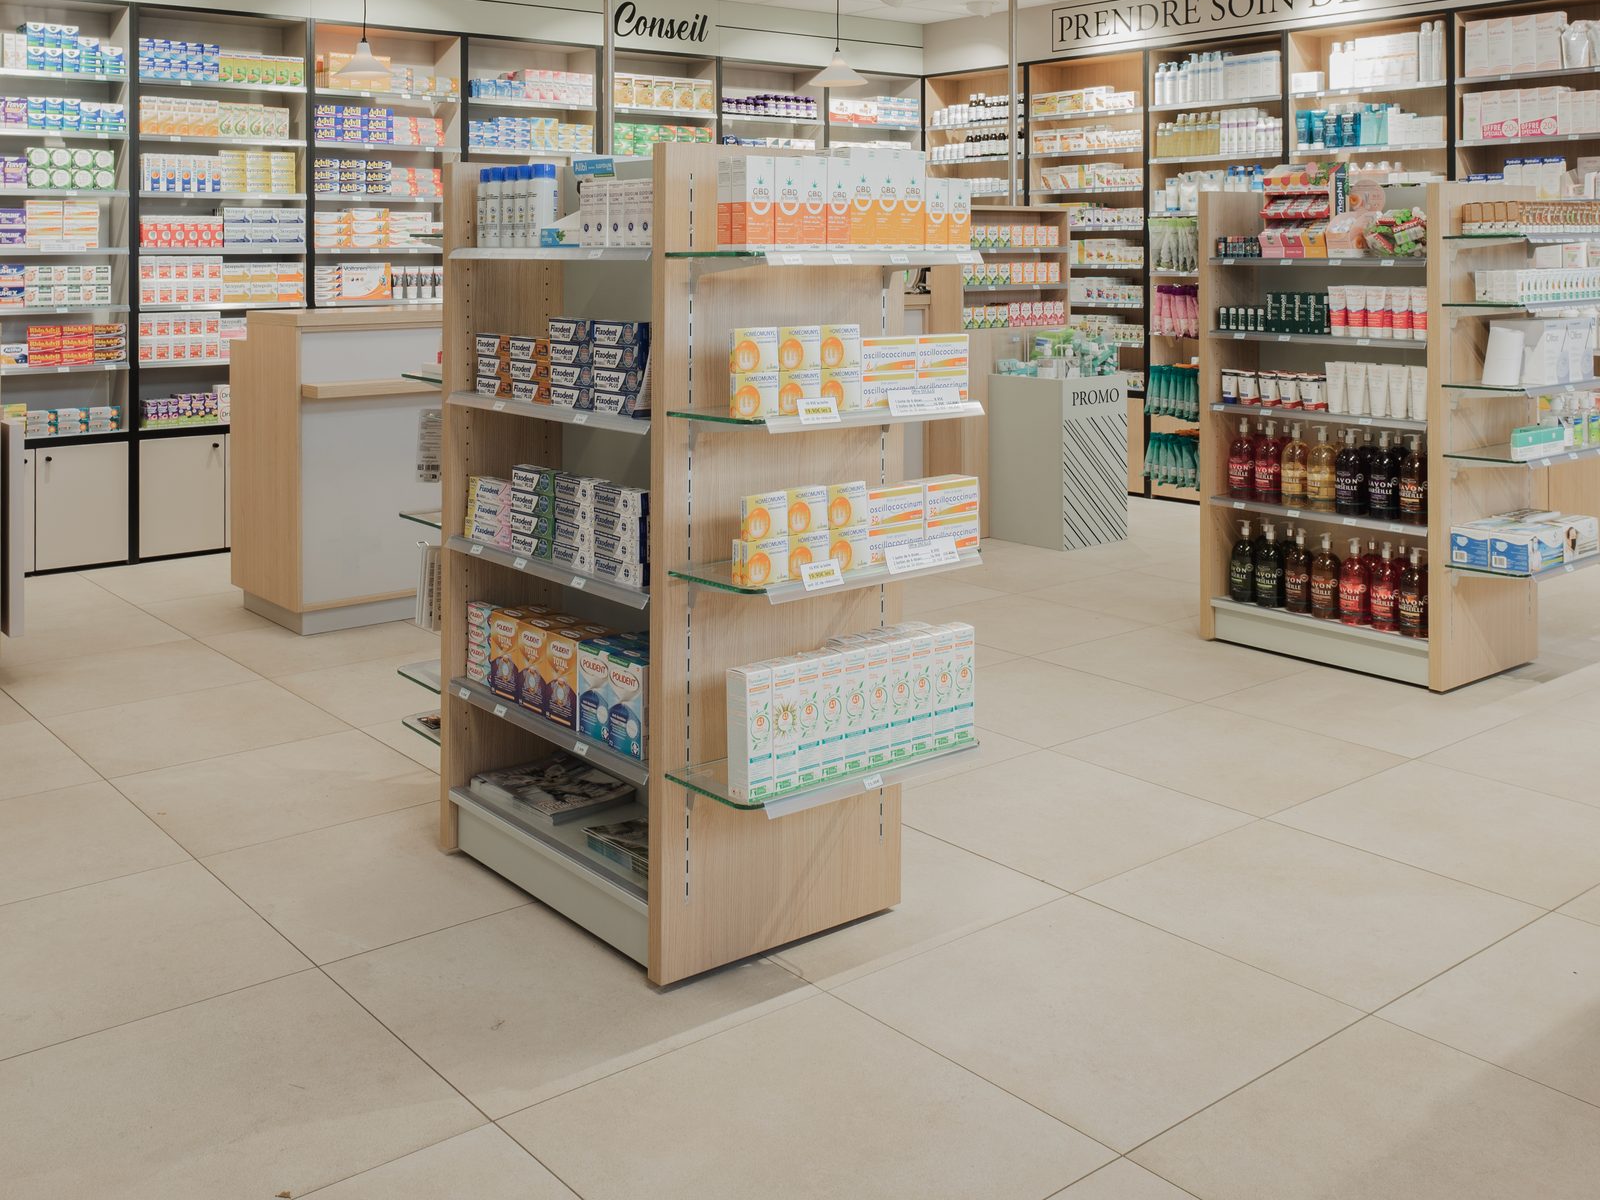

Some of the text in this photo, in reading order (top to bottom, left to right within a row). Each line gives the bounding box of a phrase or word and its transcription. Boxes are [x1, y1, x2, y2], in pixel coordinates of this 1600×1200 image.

[614, 1, 709, 42] Conseil
[318, 105, 335, 115] Advil
[343, 107, 361, 116] Advil
[369, 108, 387, 117] Advil
[316, 117, 335, 127] Advil
[343, 119, 361, 128] Advil
[369, 120, 387, 129] Advil
[316, 129, 335, 139] Advil
[343, 130, 361, 140] Advil
[369, 131, 387, 141] Advil
[753, 187, 769, 196] CBD
[782, 188, 798, 197] CBD
[833, 191, 847, 199] CBD
[856, 186, 871, 194] CBD
[881, 186, 896, 194] CBD
[905, 187, 921, 195] CBD
[1336, 182, 1345, 215] mophil
[930, 201, 944, 209] CBD
[551, 325, 571, 334] Fixodent
[596, 327, 617, 336] Fixodent
[477, 339, 495, 348] Fixodent
[511, 343, 530, 352] Fixodent
[552, 346, 573, 356] Fixodent
[595, 350, 617, 360] Fixodent
[863, 351, 916, 359] oscillococcinum
[920, 348, 967, 357] oscillococcinum
[479, 359, 495, 369] Fixodent
[511, 364, 531, 373] Fixodent
[552, 368, 575, 378] Fixodent
[595, 373, 619, 383] Fixodent
[478, 380, 496, 389] Fixodent
[513, 384, 533, 395] Fixodent
[551, 389, 574, 399] Fixodent
[1072, 387, 1119, 406] PROMO
[595, 394, 619, 405] Fixodent
[513, 473, 534, 483] Fixodent
[479, 484, 499, 495] Fixodent
[556, 482, 575, 493] Fixodent
[512, 494, 533, 504] Fixodent
[594, 492, 616, 503] Fixodent
[928, 493, 977, 505] oscillococcinum
[477, 506, 498, 516] Fixodent
[556, 504, 575, 515] Fixodent
[869, 500, 923, 514] oscillococcinum
[511, 515, 532, 526] Fixodent
[594, 514, 615, 526] Fixodent
[474, 525, 495, 537] Fixodent
[556, 525, 575, 537] Fixodent
[512, 536, 533, 547] Fixodent
[595, 537, 615, 549] Fixodent
[553, 547, 573, 559] Fixodent
[595, 559, 617, 571] Fixodent
[496, 623, 513, 633] POLIDENT
[523, 633, 540, 643] POLIDENT
[552, 644, 570, 654] POLIDENT
[582, 660, 606, 673] POLIDENT
[612, 672, 637, 687] POLIDENT
